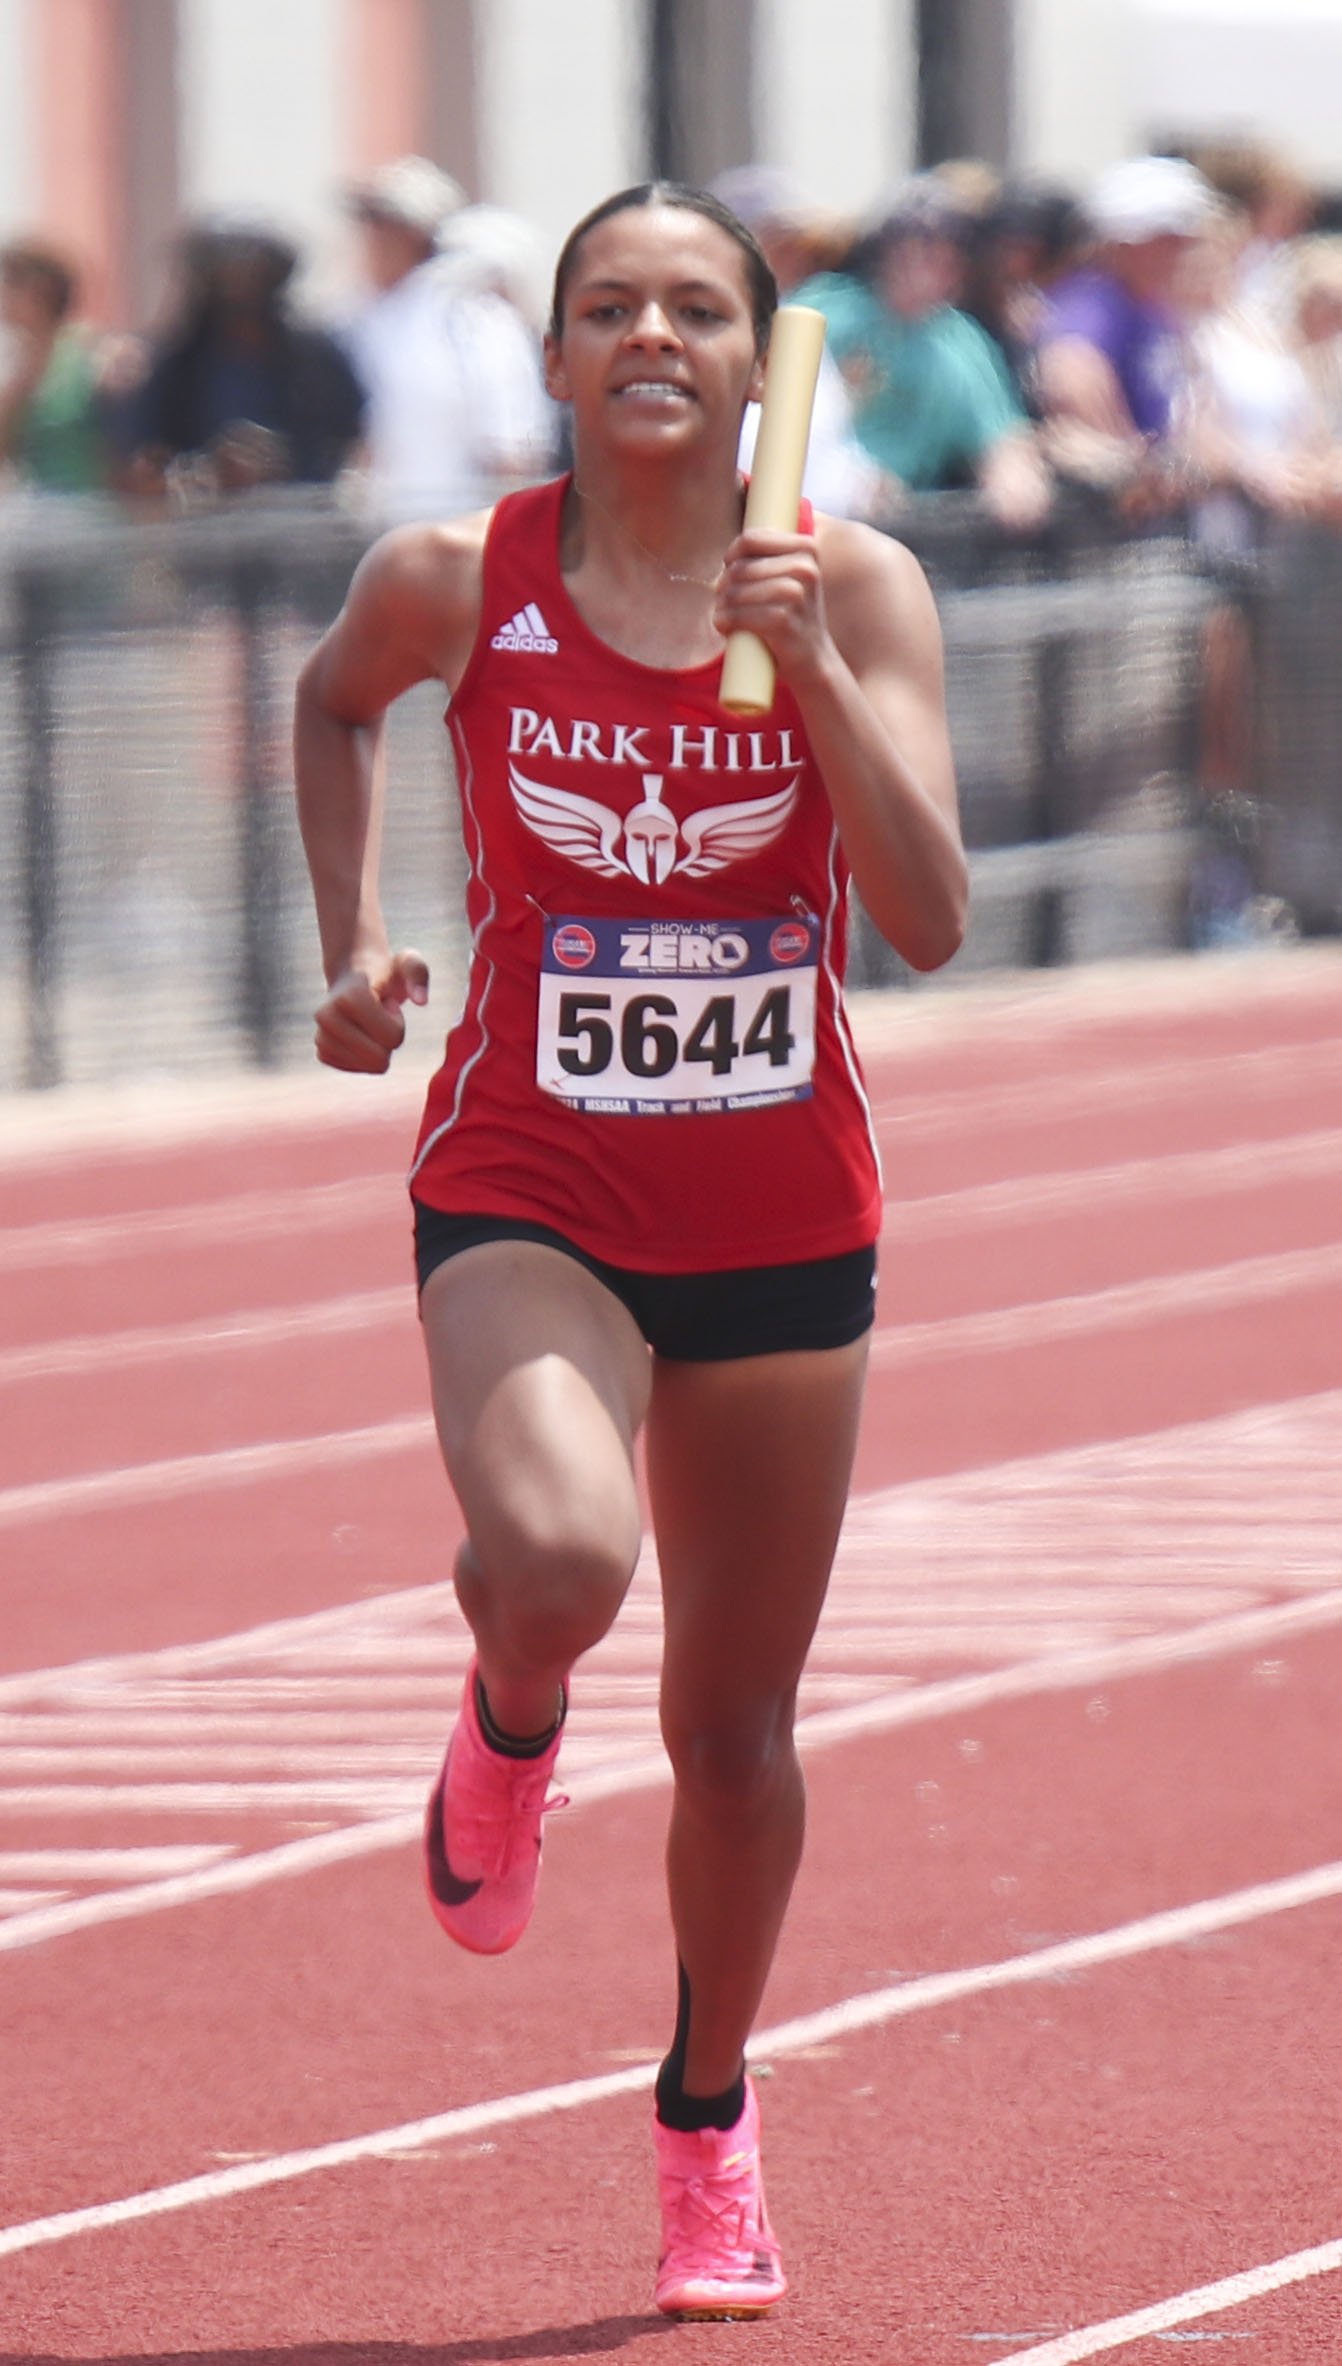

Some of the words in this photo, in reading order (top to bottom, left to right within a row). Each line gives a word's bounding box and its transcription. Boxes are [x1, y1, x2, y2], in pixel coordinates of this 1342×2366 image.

[491, 633, 559, 654] adidas
[508, 706, 651, 766] PARK
[669, 723, 804, 771] HILL
[651, 923, 719, 935] SHOW-ME
[619, 934, 749, 970] ZERO
[557, 985, 794, 1077] 5644
[637, 1099, 666, 1113] Track
[671, 1101, 692, 1113] and
[696, 1098, 722, 1112] Field
